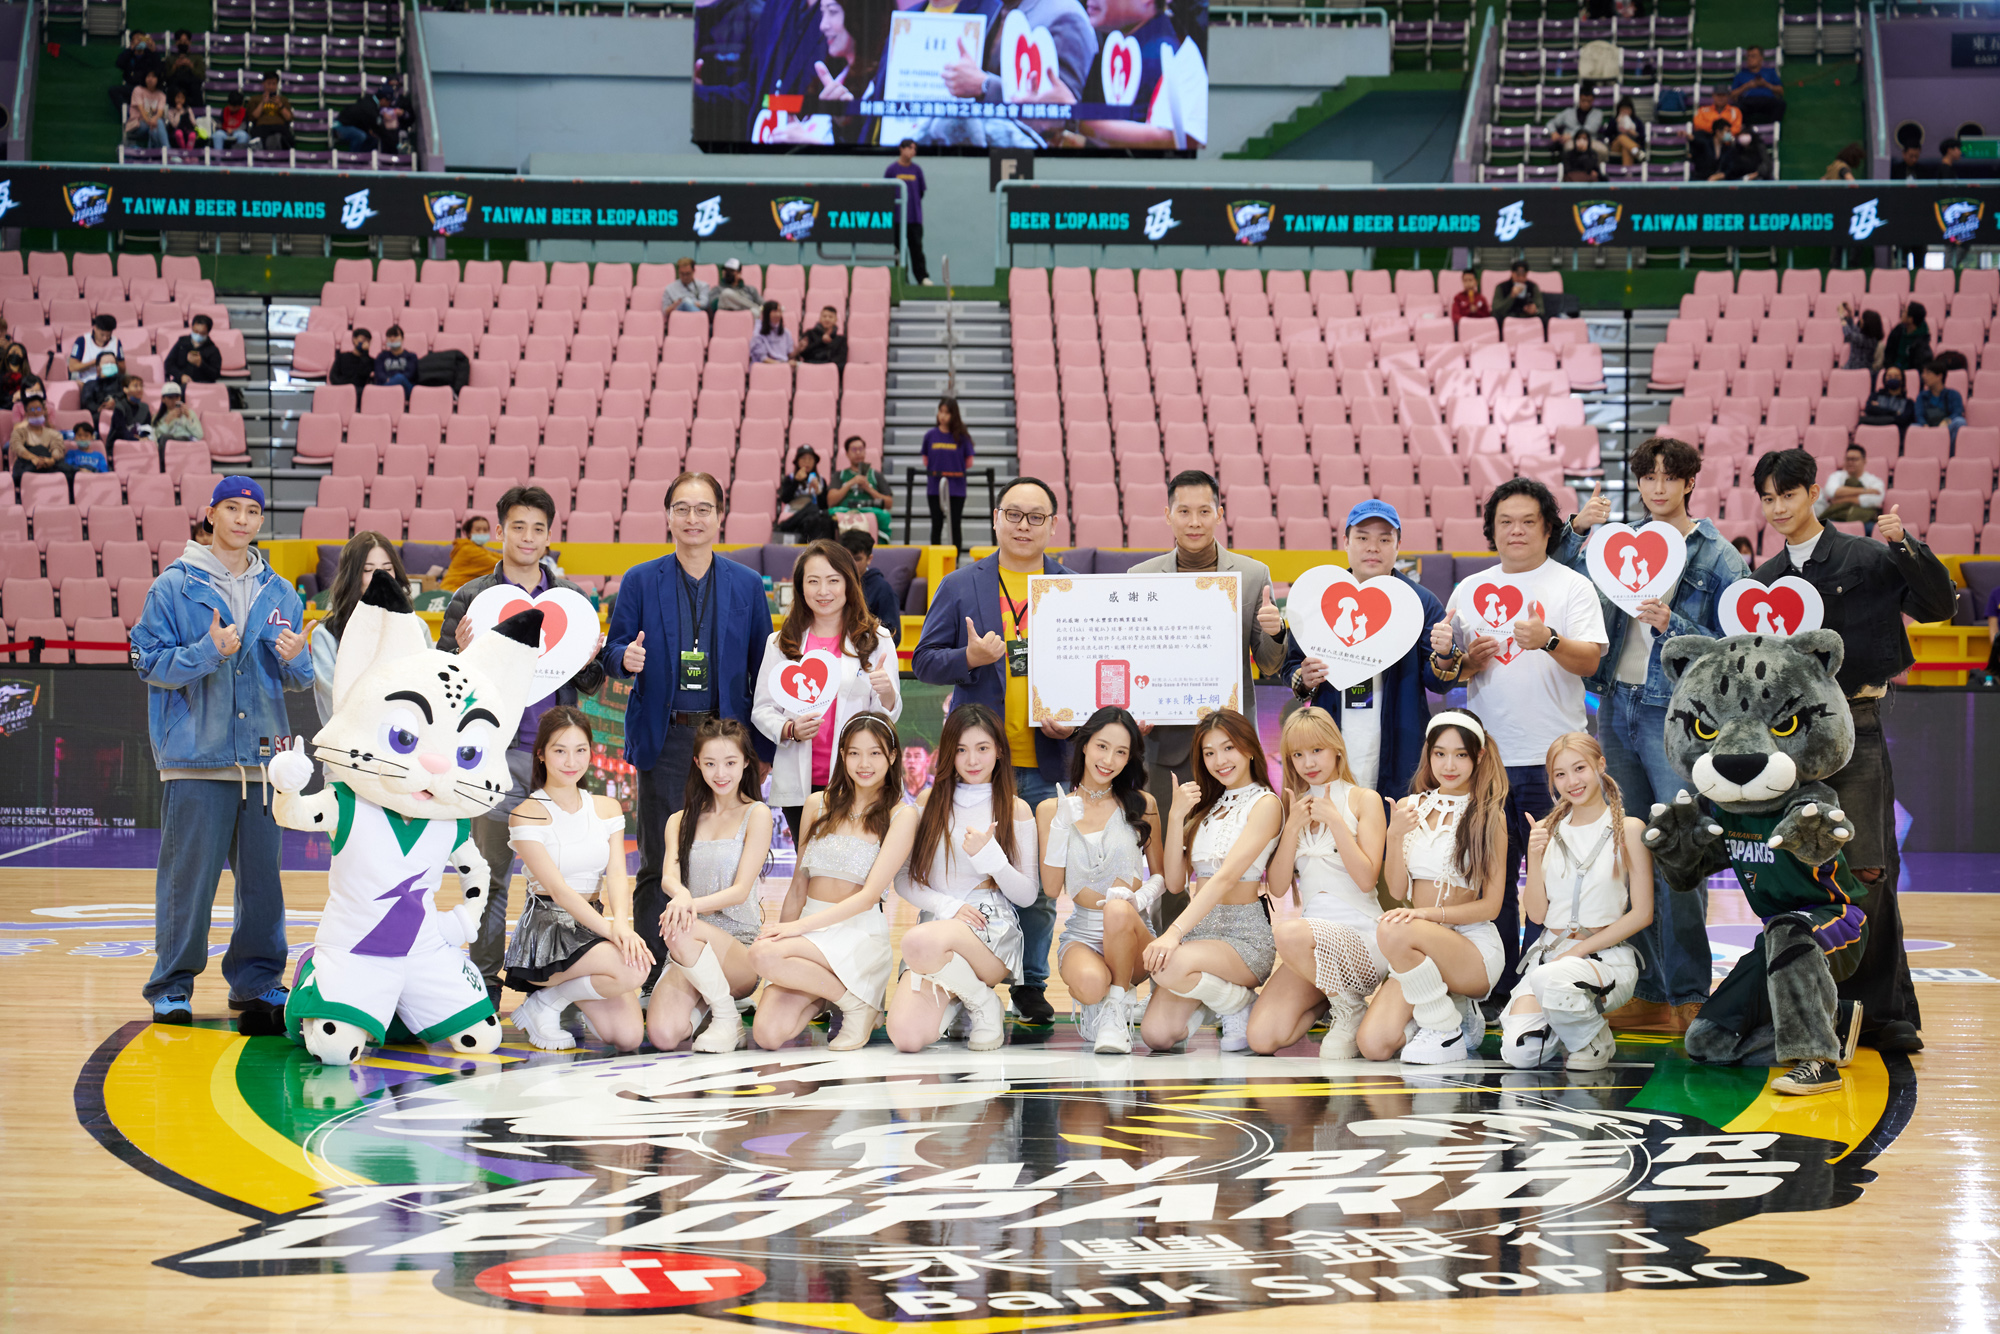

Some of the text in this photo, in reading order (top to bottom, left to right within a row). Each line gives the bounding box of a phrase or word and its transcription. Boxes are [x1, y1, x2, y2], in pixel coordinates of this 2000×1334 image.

[123, 198, 189, 215] TAIWAN
[196, 199, 236, 216] BEER
[242, 201, 325, 218] LEOPARDS
[482, 206, 546, 224] TAIWAN
[552, 208, 591, 225] BEER
[597, 209, 678, 226] LEOPARDS
[828, 211, 893, 228] TAIWAN
[1010, 212, 1050, 229] BEER
[1284, 215, 1349, 232] TAIWAN
[1353, 215, 1393, 232] BEER
[1398, 215, 1480, 232] LEOPARDS
[1631, 214, 1698, 231] TAIWAN
[1703, 214, 1744, 231] BEER
[1750, 214, 1833, 230] LEOPARDS
[1108, 591, 1159, 603] 感謝狀
[25, 807, 46, 816] BEER
[49, 807, 94, 817] LEOPARDS
[55, 817, 109, 827] BASKETBALL
[112, 818, 136, 827] TEAM
[297, 1133, 1781, 1217] TAIWAN BEER
[180, 1161, 1801, 1263] LEOPARDS
[854, 1219, 1670, 1282] 永豐銀行
[885, 1262, 1768, 1316] Bank SinoPac
